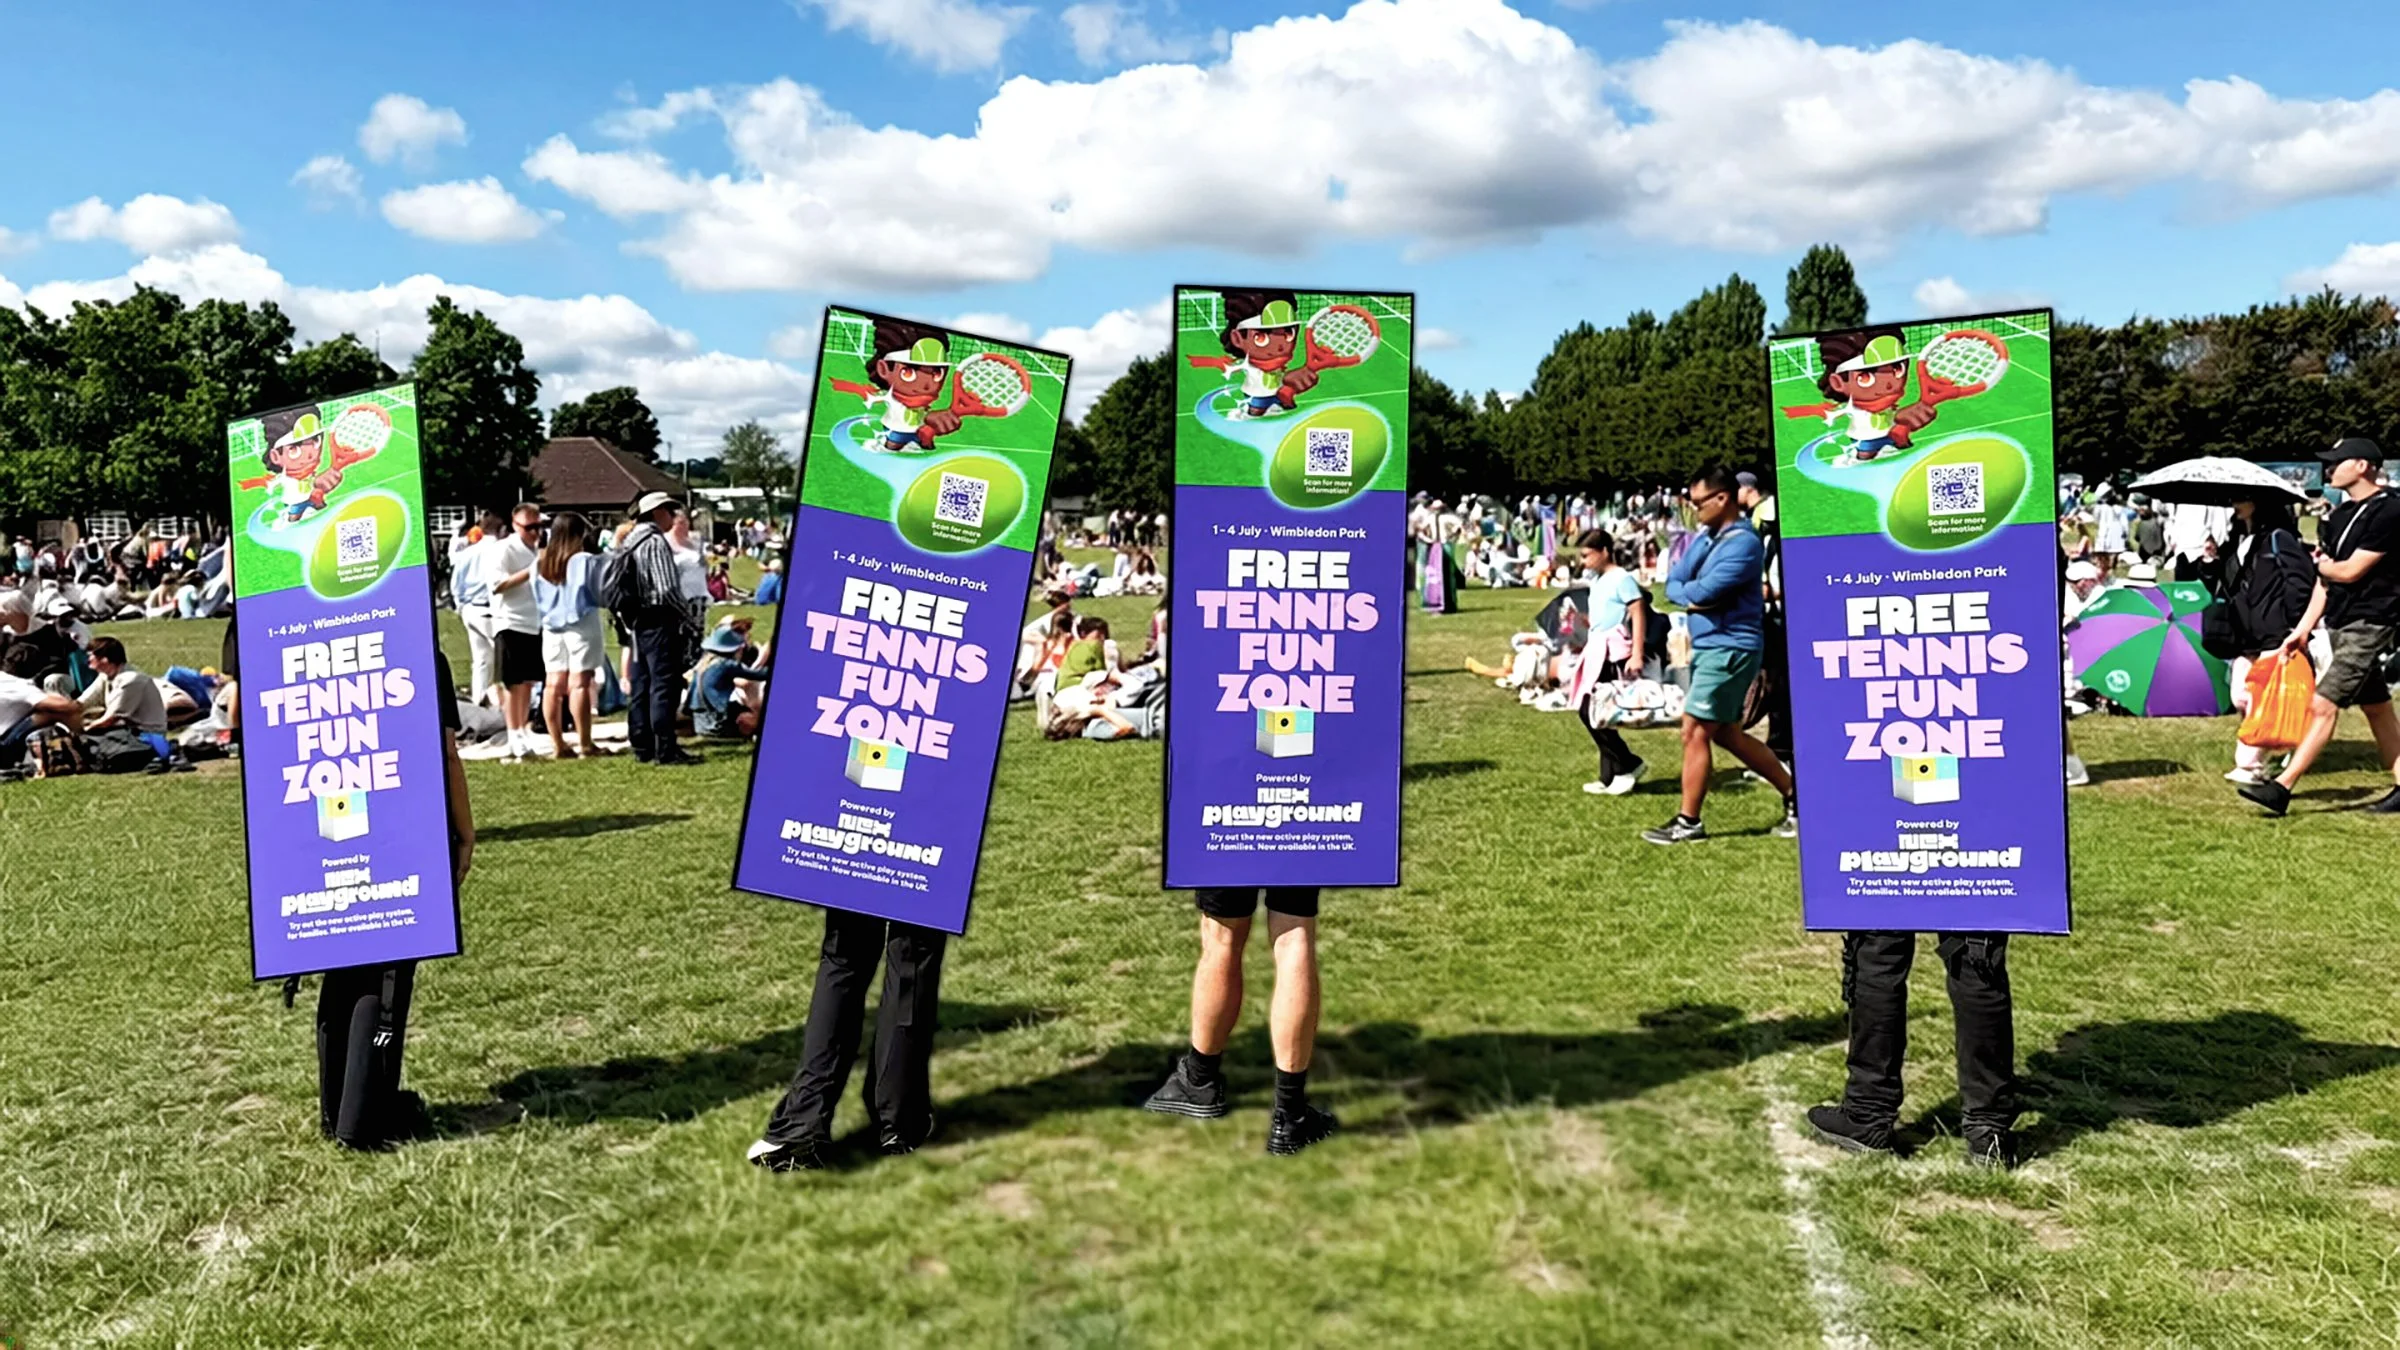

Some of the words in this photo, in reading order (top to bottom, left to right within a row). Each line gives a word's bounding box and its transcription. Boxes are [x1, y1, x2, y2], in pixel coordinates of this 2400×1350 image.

[1303, 478, 1322, 486] Scan
[931, 521, 950, 531] Scan
[950, 525, 962, 533] for
[962, 529, 981, 538] more
[1238, 525, 1262, 538] July
[1270, 526, 1337, 538] Wimbledon
[1339, 527, 1366, 539] Park
[1927, 519, 1949, 527] Scan
[1950, 517, 1963, 525] for
[857, 555, 882, 571] July
[891, 561, 958, 586] Wimbledon
[959, 576, 988, 592] Park
[1227, 549, 1351, 590] FREE
[1855, 572, 1883, 585] July
[1891, 568, 1972, 582] Wimbledon
[1974, 565, 2007, 578] Park
[288, 622, 307, 635] July
[313, 612, 370, 630] Wimbledon
[371, 606, 396, 619] Park
[840, 576, 969, 639] FREE
[1195, 590, 1379, 632] TENNIS
[1845, 591, 1991, 637] FREE
[281, 630, 386, 685] FREE
[806, 610, 988, 683] TENNIS
[1239, 632, 1335, 672] FUN
[1812, 632, 2029, 679] TENNIS
[259, 667, 415, 727] TENNIS
[838, 660, 940, 716] FUN
[1215, 673, 1355, 714] ZONE
[1865, 677, 1978, 719] FUN
[296, 712, 379, 762] FUN
[810, 695, 954, 760] ZONE
[1844, 718, 2005, 761] ZONE
[282, 749, 401, 804] ZONE
[1256, 773, 1298, 783] Powered
[1299, 774, 1311, 784] by
[839, 799, 882, 815] Powered
[882, 807, 896, 819] by
[1895, 819, 1944, 829] Powered
[1945, 819, 1959, 830] by
[1206, 842, 1219, 851] for
[1257, 842, 1277, 851] Now
[1277, 842, 1316, 851] available
[1317, 842, 1326, 850] in
[1326, 842, 1341, 850] the
[1209, 832, 1224, 842] Try
[1224, 833, 1239, 841] out
[1240, 833, 1255, 841] the
[1274, 833, 1301, 841] active
[1301, 832, 1321, 842] play
[321, 854, 359, 868] Powered
[359, 853, 370, 864] by
[781, 854, 794, 864] for
[831, 865, 851, 875] Now
[851, 870, 890, 884] available
[890, 877, 899, 886] in
[900, 880, 914, 889] the
[787, 845, 800, 857] Try
[800, 850, 815, 859] out
[816, 853, 830, 862] the
[831, 857, 849, 865] new
[849, 860, 876, 871] active
[876, 865, 896, 877] play
[1846, 887, 1861, 896] for
[1903, 887, 1925, 896] Now
[1925, 887, 1971, 896] available
[1971, 887, 1982, 896] in
[1982, 887, 2001, 896] the
[1849, 877, 1865, 887] Try
[1866, 878, 1882, 886] out
[1883, 878, 1899, 886] the
[1921, 878, 1952, 886] active
[1953, 877, 1975, 888] play
